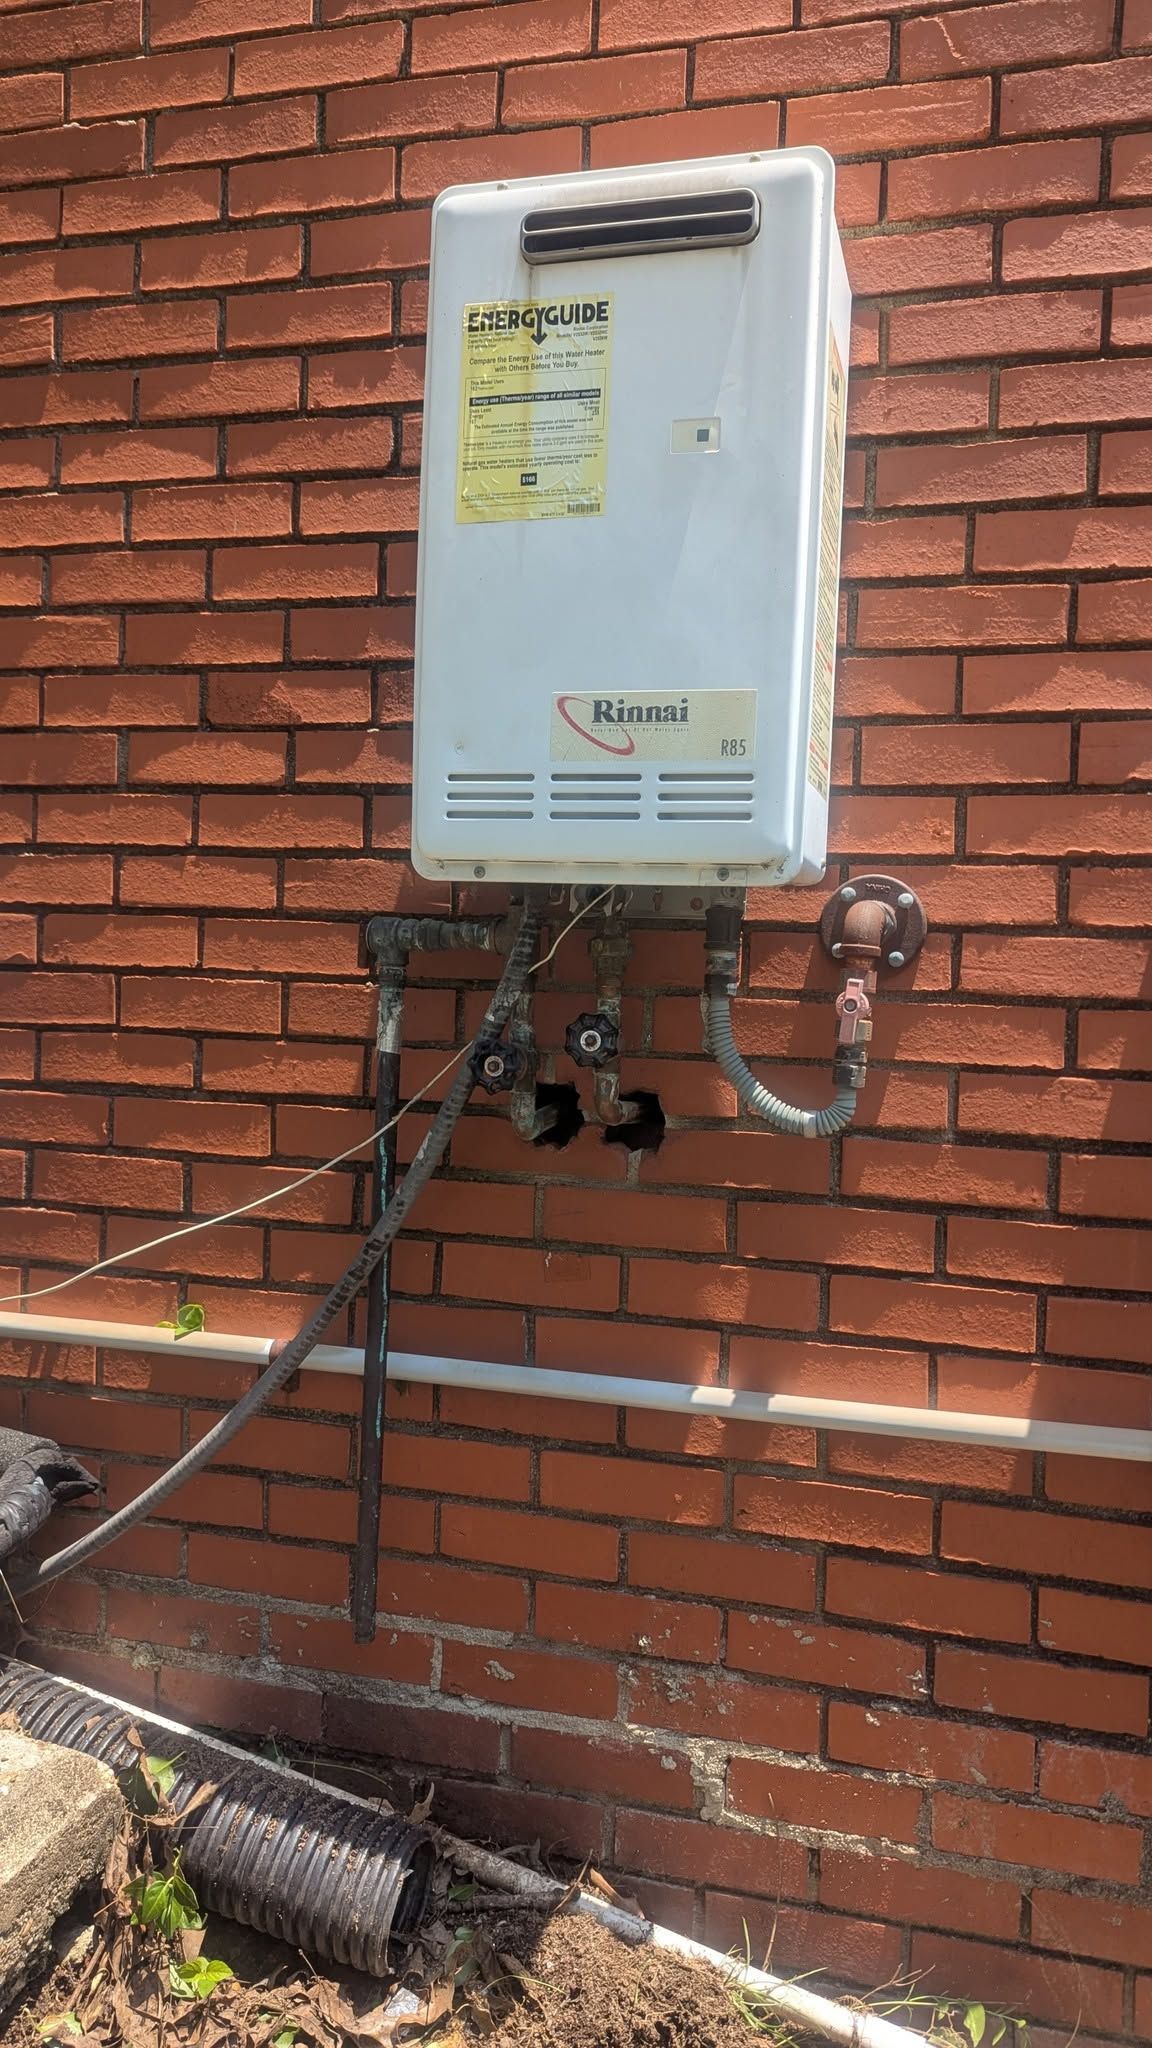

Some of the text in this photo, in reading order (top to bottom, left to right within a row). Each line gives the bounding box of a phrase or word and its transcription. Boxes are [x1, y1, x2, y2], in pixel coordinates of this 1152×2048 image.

[468, 301, 608, 337] ENERGYGUIDE
[469, 357, 496, 366] Compare
[508, 355, 530, 364] Energy
[584, 349, 605, 357] Heater
[508, 364, 530, 372] Others
[530, 362, 551, 370] Before
[534, 393, 550, 401] range
[591, 698, 689, 724] Rinnai
[720, 738, 746, 756] R85
